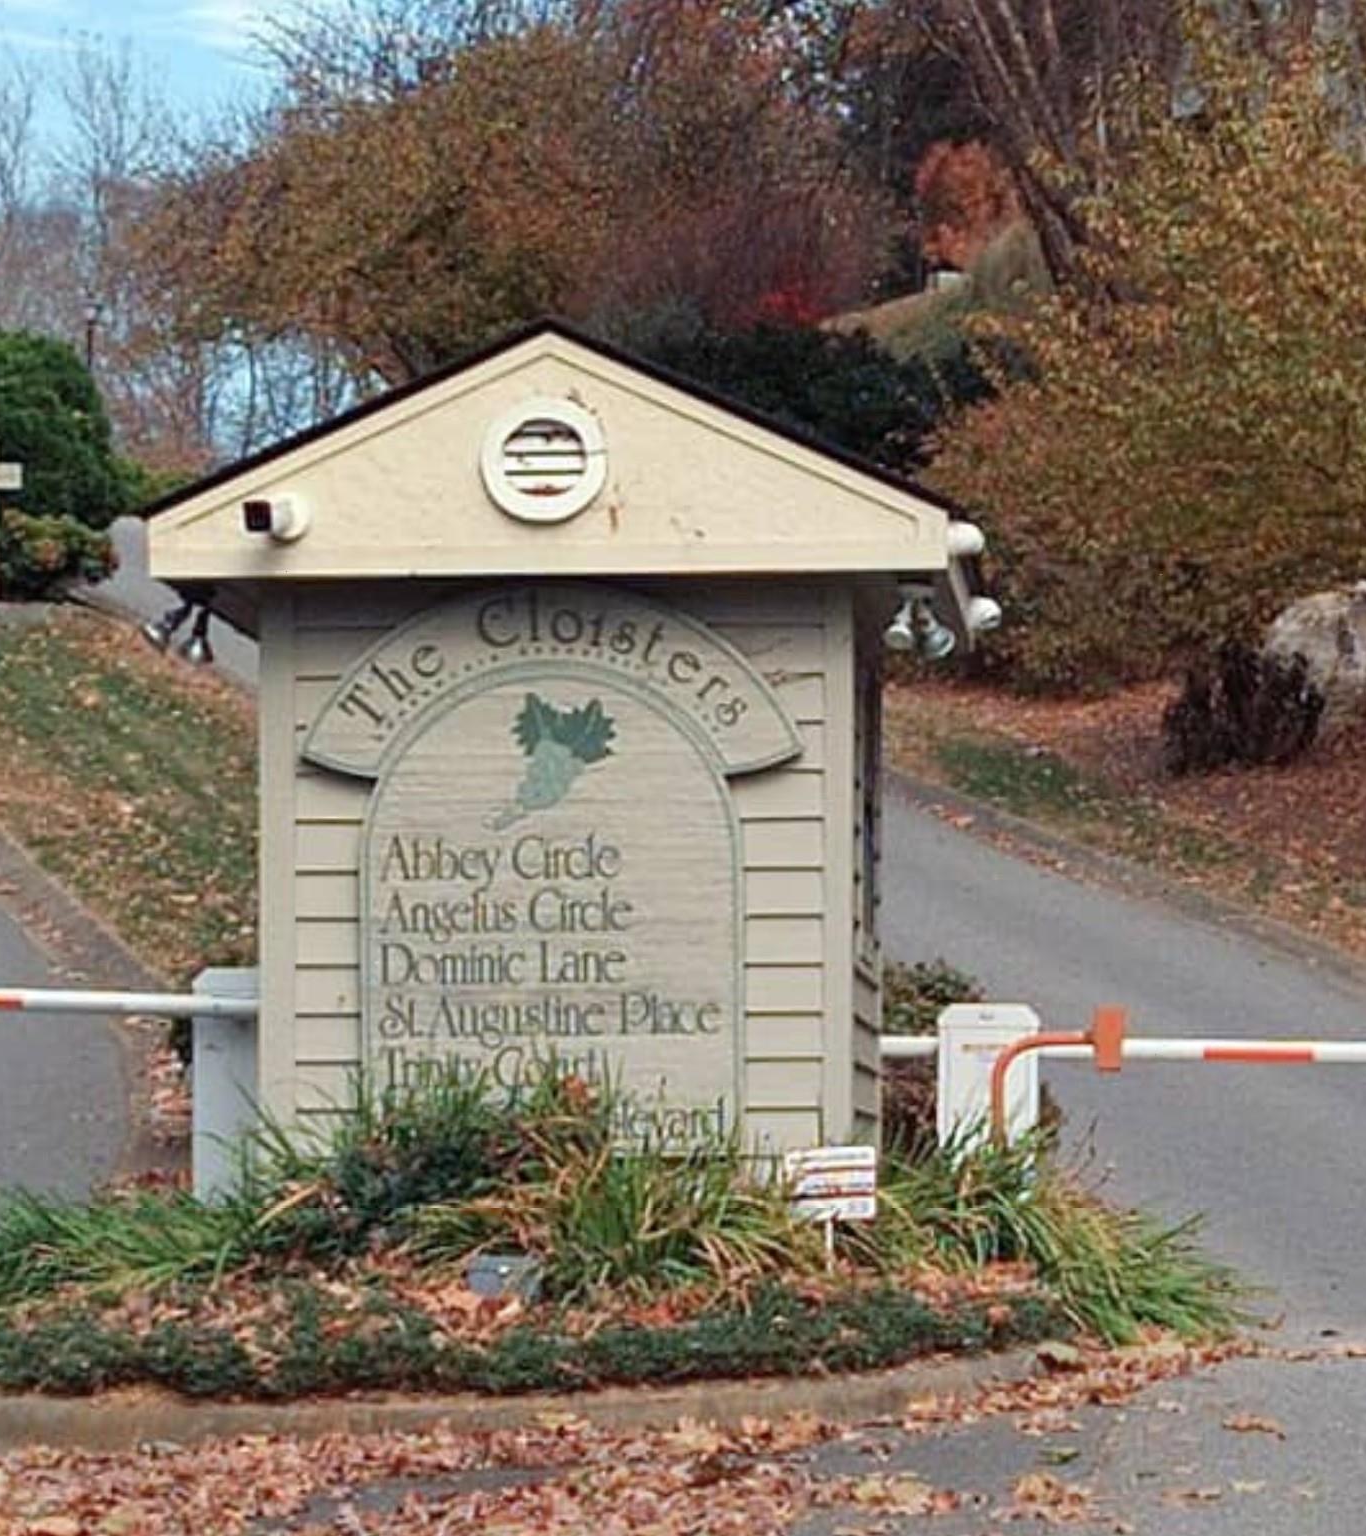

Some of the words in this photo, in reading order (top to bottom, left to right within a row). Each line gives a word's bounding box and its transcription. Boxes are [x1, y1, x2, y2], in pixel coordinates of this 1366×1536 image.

[339, 643, 444, 727] The
[476, 596, 748, 727] Cloisters
[380, 834, 501, 893] Abbey
[512, 833, 621, 880] Circle
[379, 889, 518, 944] Angelus
[529, 886, 634, 933] Circle
[380, 941, 527, 985] Dominic
[540, 941, 627, 984] Lane
[427, 994, 606, 1050] Augustine
[619, 992, 722, 1036] Place
